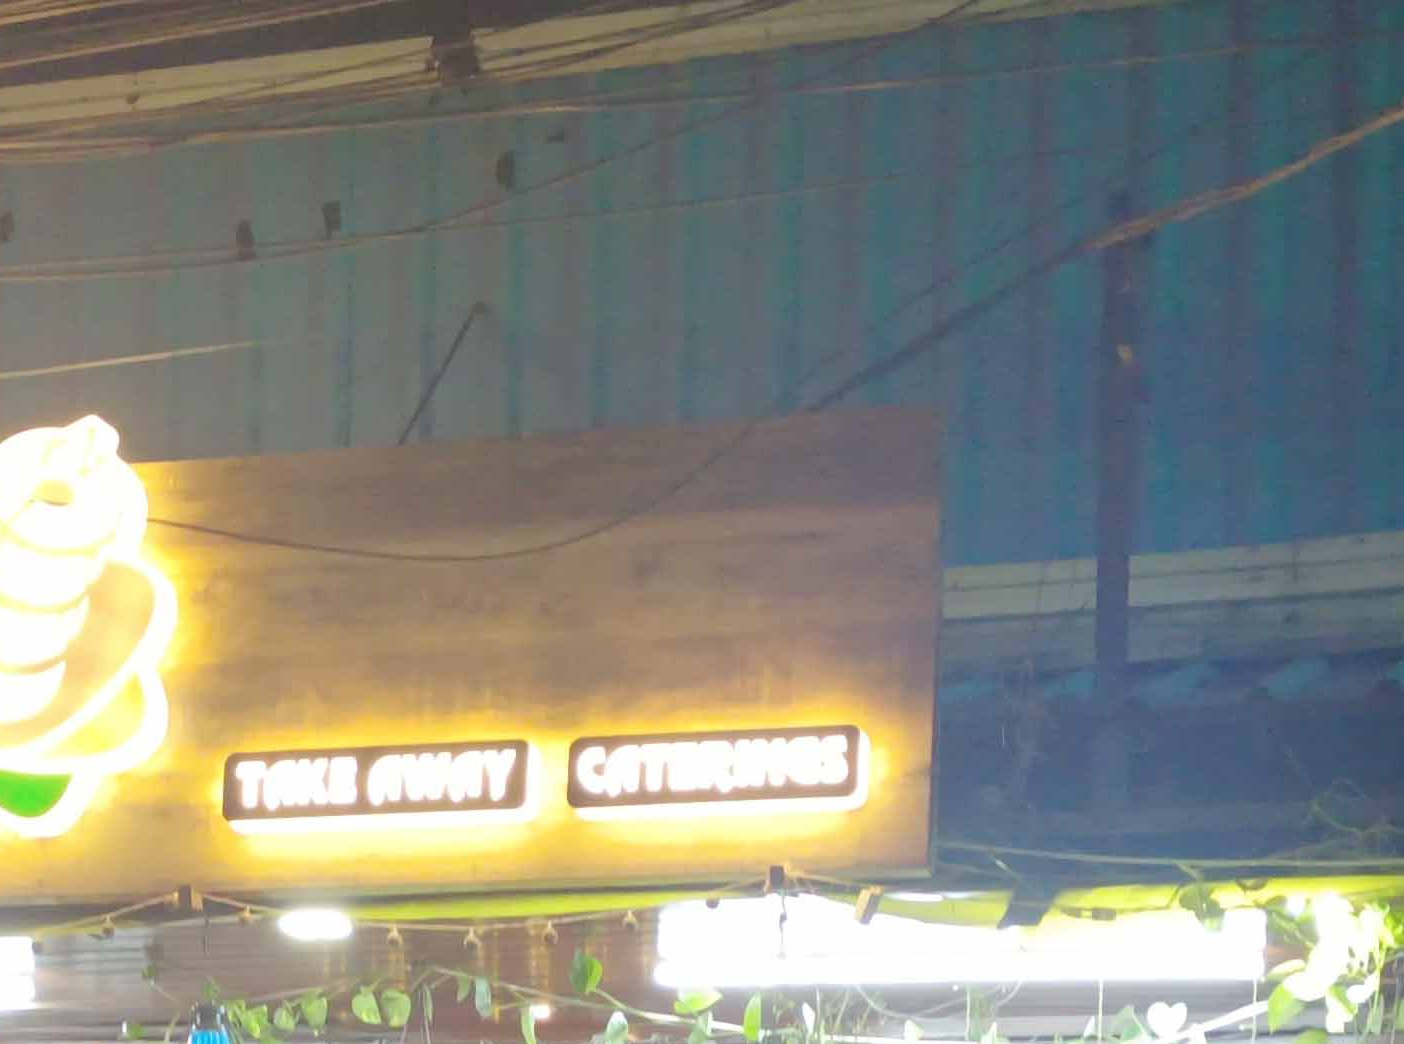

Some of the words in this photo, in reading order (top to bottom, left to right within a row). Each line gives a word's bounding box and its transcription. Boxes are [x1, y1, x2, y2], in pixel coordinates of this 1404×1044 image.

[236, 760, 357, 809] TAKE
[367, 749, 518, 804] AWAY
[576, 735, 849, 798] CATERINGS
